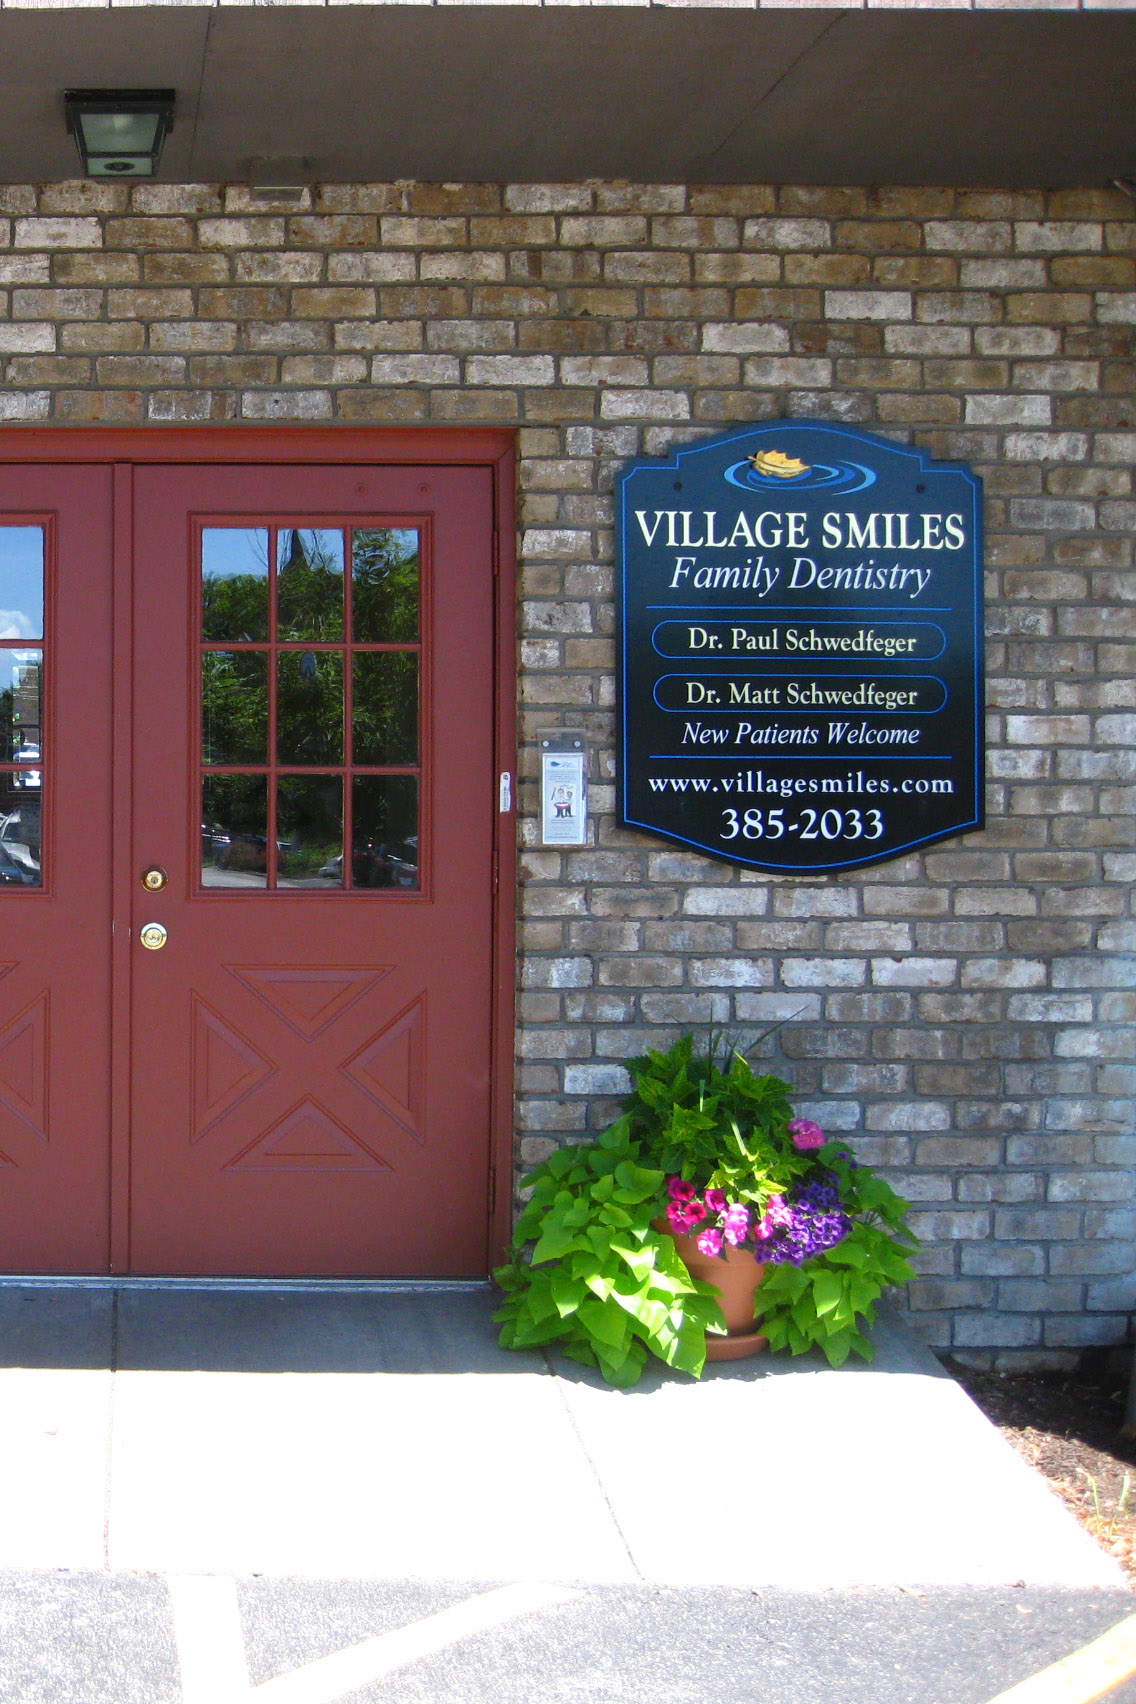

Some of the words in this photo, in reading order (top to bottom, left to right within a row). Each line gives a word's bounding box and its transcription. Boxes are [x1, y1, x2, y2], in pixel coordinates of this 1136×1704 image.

[634, 510, 809, 548] VILLAGE
[822, 511, 965, 550] SMILES
[668, 556, 780, 598] Family
[787, 557, 931, 599] Dentistry
[688, 627, 723, 650] Dr.
[731, 628, 779, 651] Paul
[785, 629, 917, 657] Schwedfeger
[685, 682, 722, 704] Dr.
[728, 682, 780, 705] Matt
[786, 682, 918, 710] Schwedfeger
[681, 723, 729, 744] New
[734, 722, 819, 744] Patients
[826, 722, 921, 744] Welcome
[648, 771, 954, 797] www.villagesmiles.com
[719, 808, 884, 840] 385-2033
